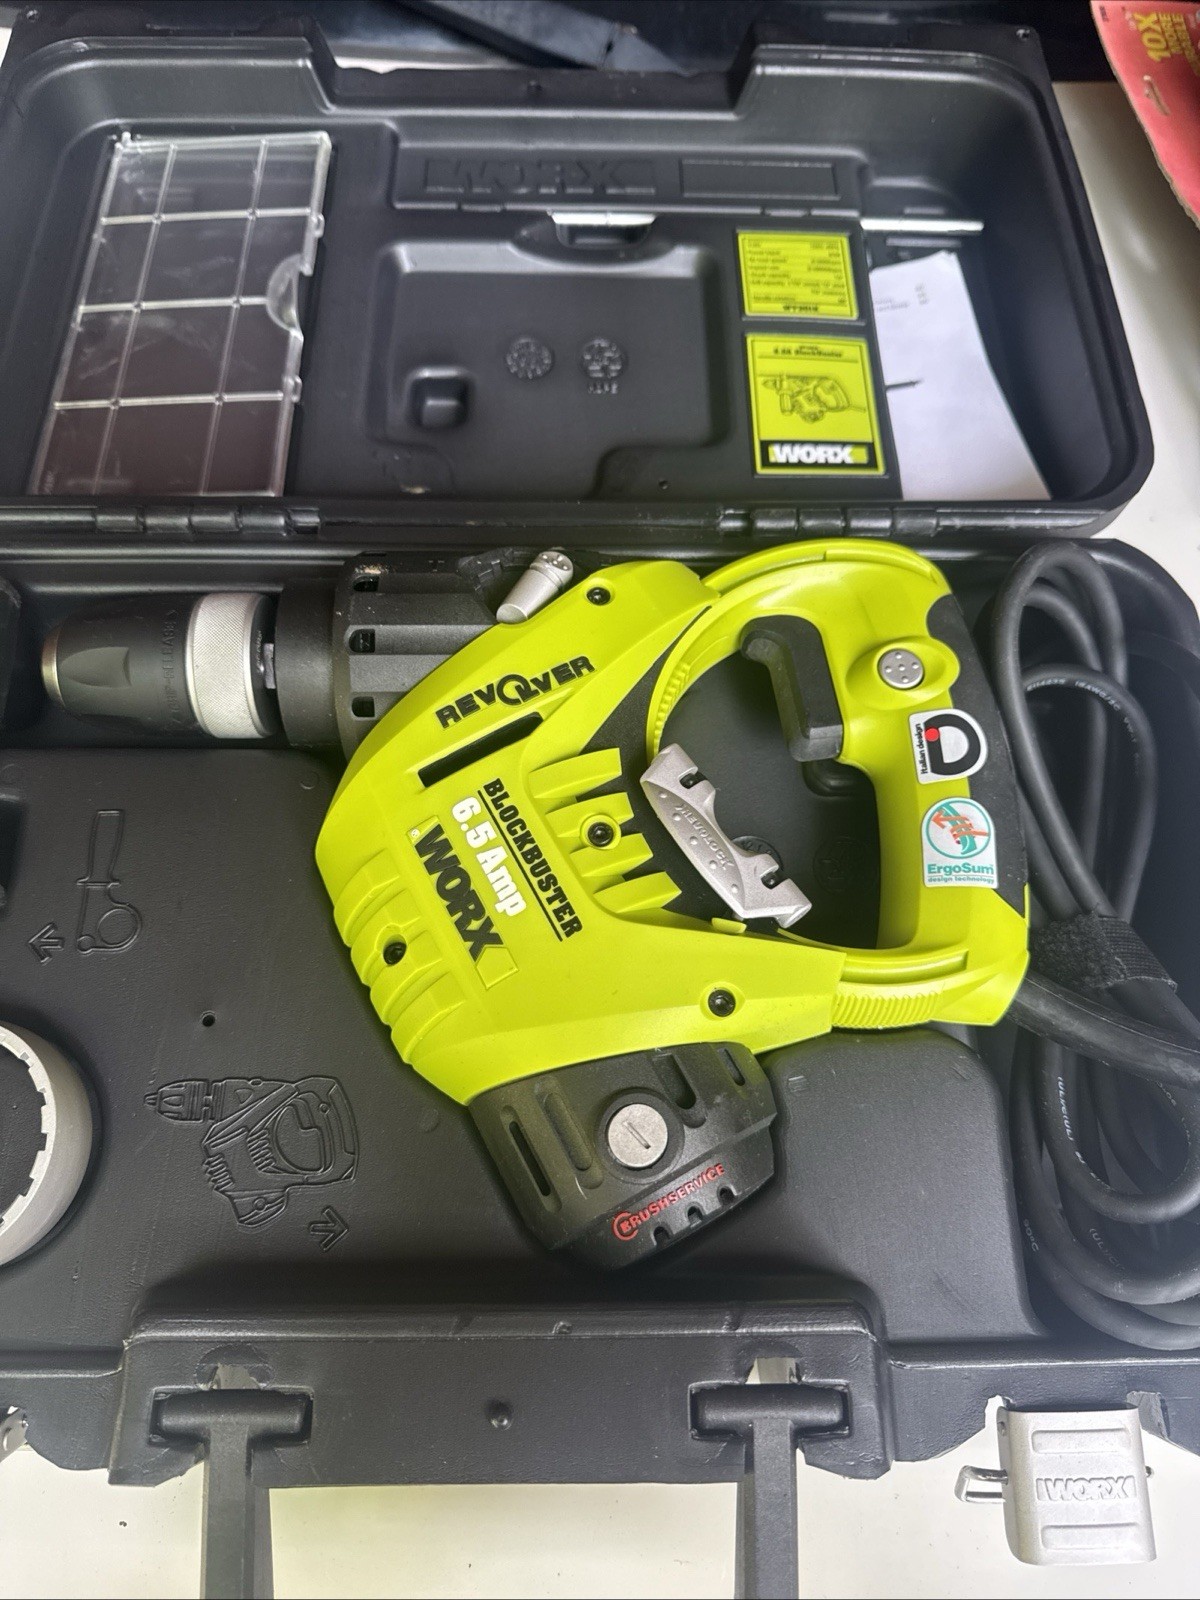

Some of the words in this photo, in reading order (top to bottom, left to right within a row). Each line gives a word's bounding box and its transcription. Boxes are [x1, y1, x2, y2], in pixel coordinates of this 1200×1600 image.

[1133, 12, 1171, 62] 10X
[771, 443, 855, 464] WORX
[435, 655, 596, 729] REVOLVER
[915, 723, 925, 750] design
[918, 750, 929, 774] Italian
[452, 796, 498, 849] 6.5
[475, 845, 527, 917] Amp
[483, 778, 583, 938] BLOCKBUSTER
[927, 862, 995, 876] ErgoSum
[414, 823, 504, 962] WORX
[927, 876, 953, 884] design
[954, 876, 995, 885] technology
[1042, 1475, 1132, 1502] WORX
